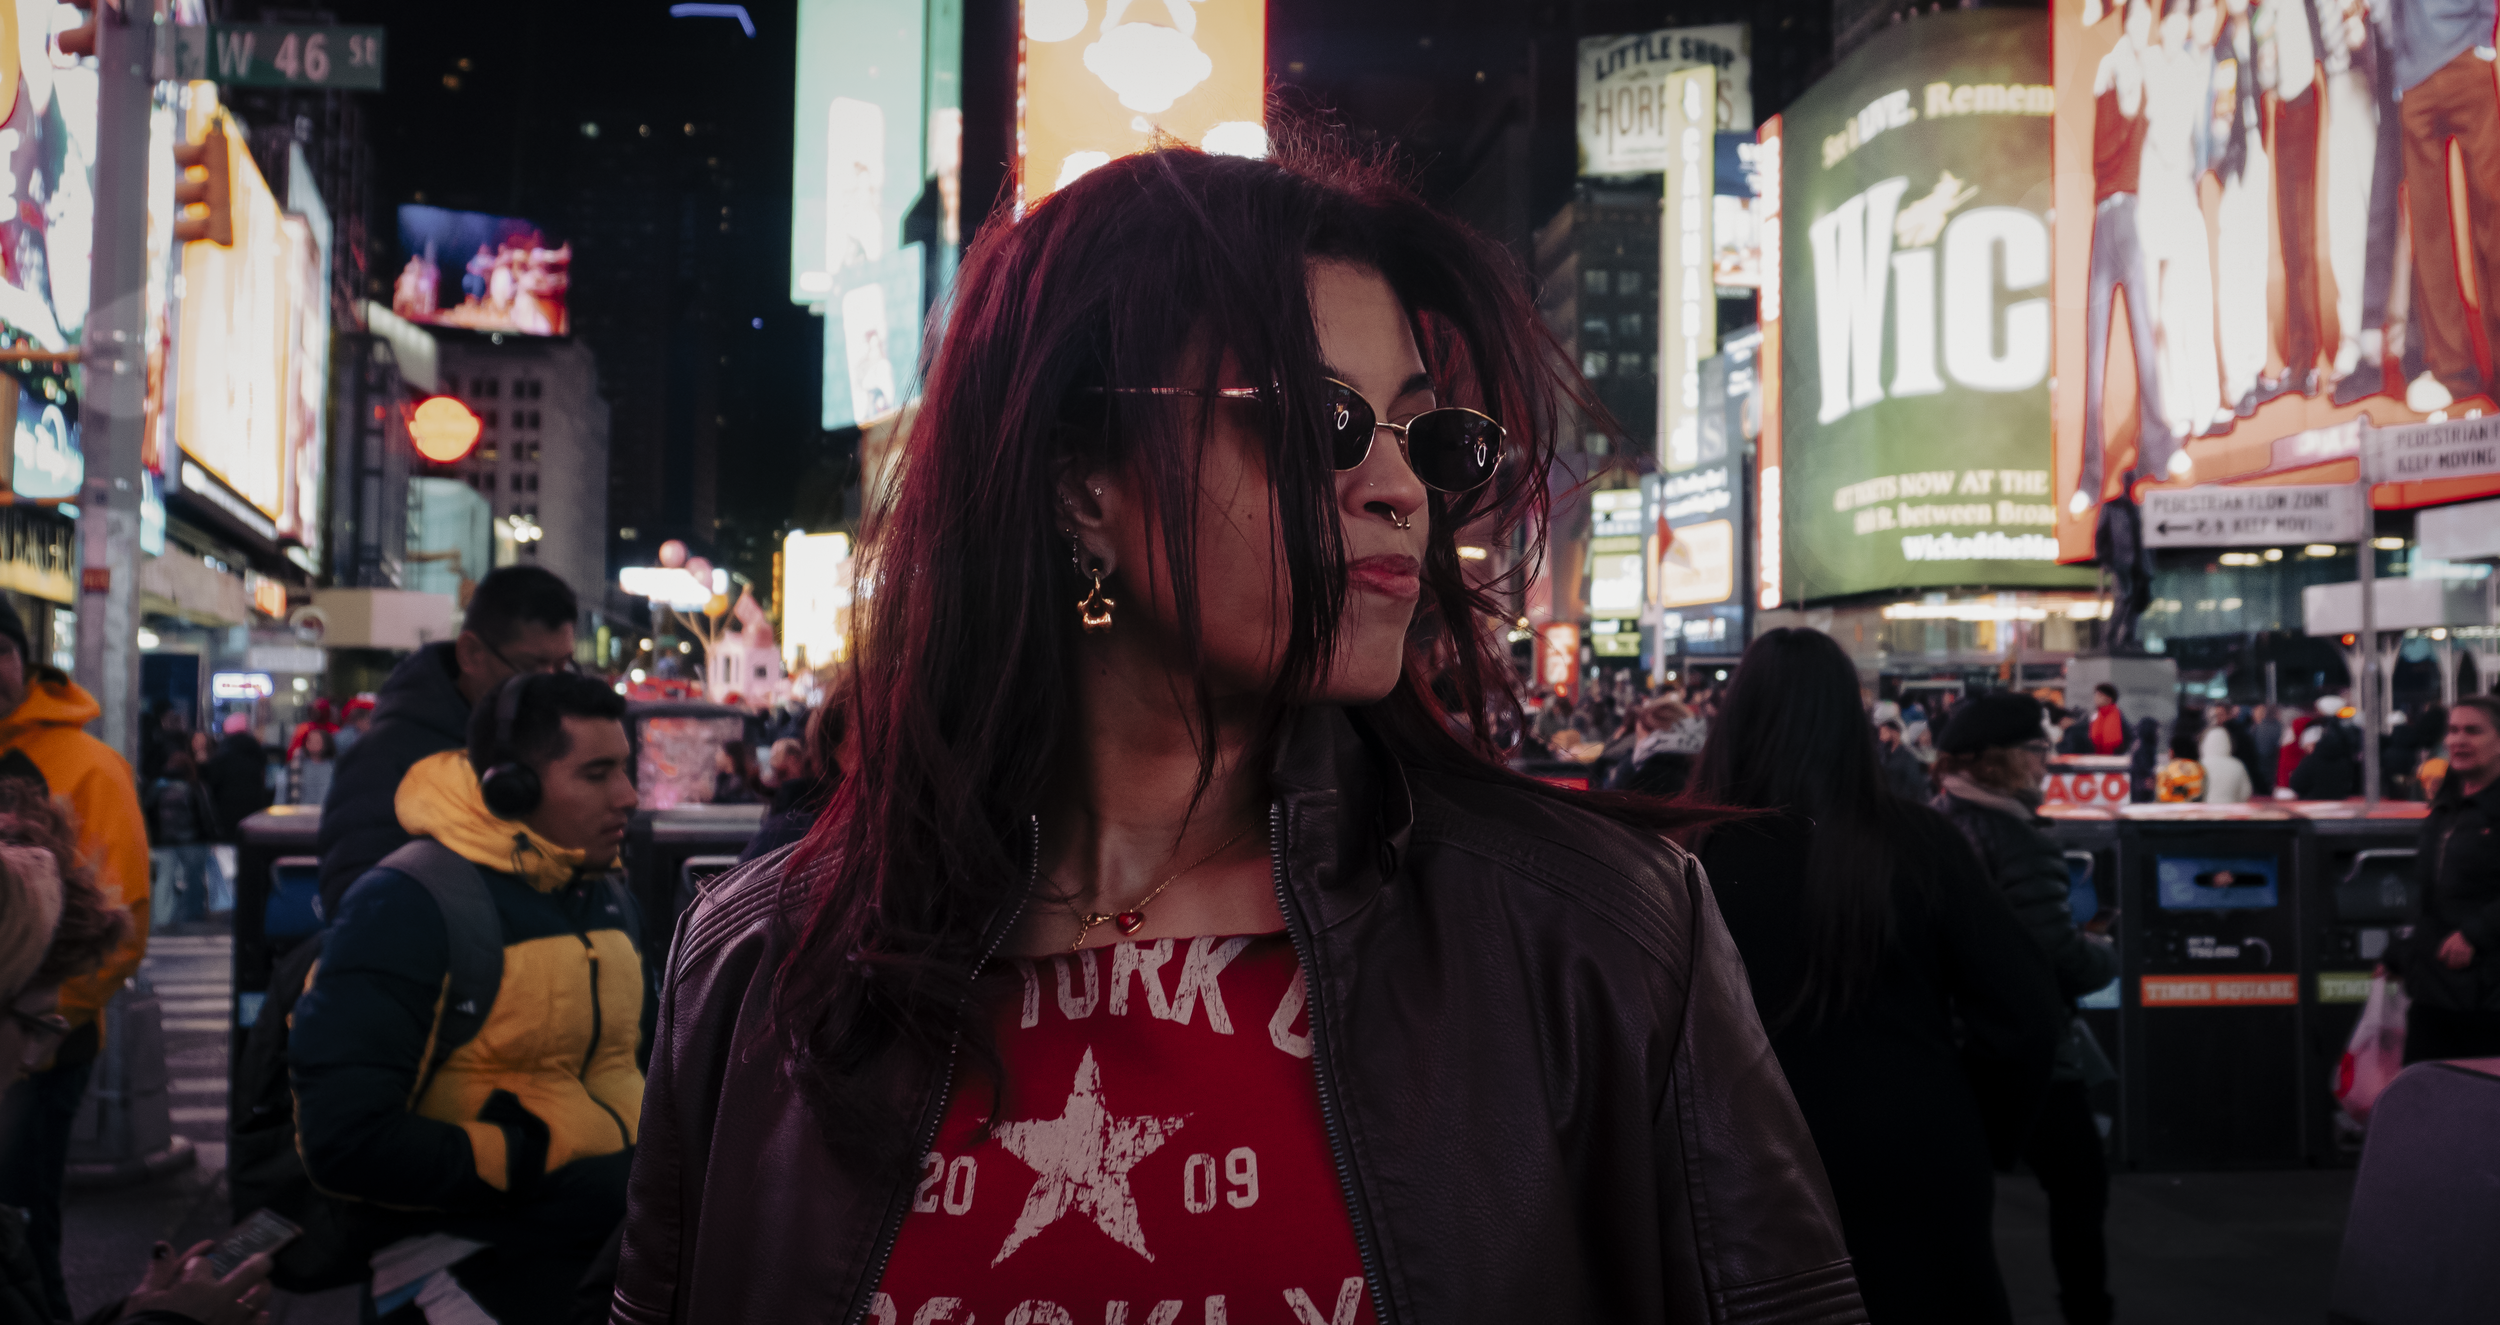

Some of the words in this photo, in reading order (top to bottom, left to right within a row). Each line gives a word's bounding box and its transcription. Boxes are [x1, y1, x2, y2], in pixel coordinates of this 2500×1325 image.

[216, 31, 256, 78] W
[274, 32, 330, 81] 46
[350, 34, 377, 67] St
[1596, 36, 1671, 81] LITTLE
[1680, 34, 1735, 70] SHOP
[2398, 424, 2488, 447] PEDESTRIAN
[2398, 455, 2430, 472] KEEP
[2439, 447, 2497, 469] MOVING
[1899, 470, 1955, 498] NOW
[1959, 470, 1994, 495] AT
[2000, 470, 2048, 495] THE
[1898, 501, 1992, 528] between
[2154, 495, 2243, 513] PEDESTRIAN
[2250, 493, 2287, 510] FLOW
[2293, 492, 2329, 509] ZONE
[2146, 982, 2210, 1000] TIMES
[2215, 981, 2293, 1000] SQUARE
[912, 1152, 977, 1216] 20
[1183, 1146, 1259, 1214] 09
